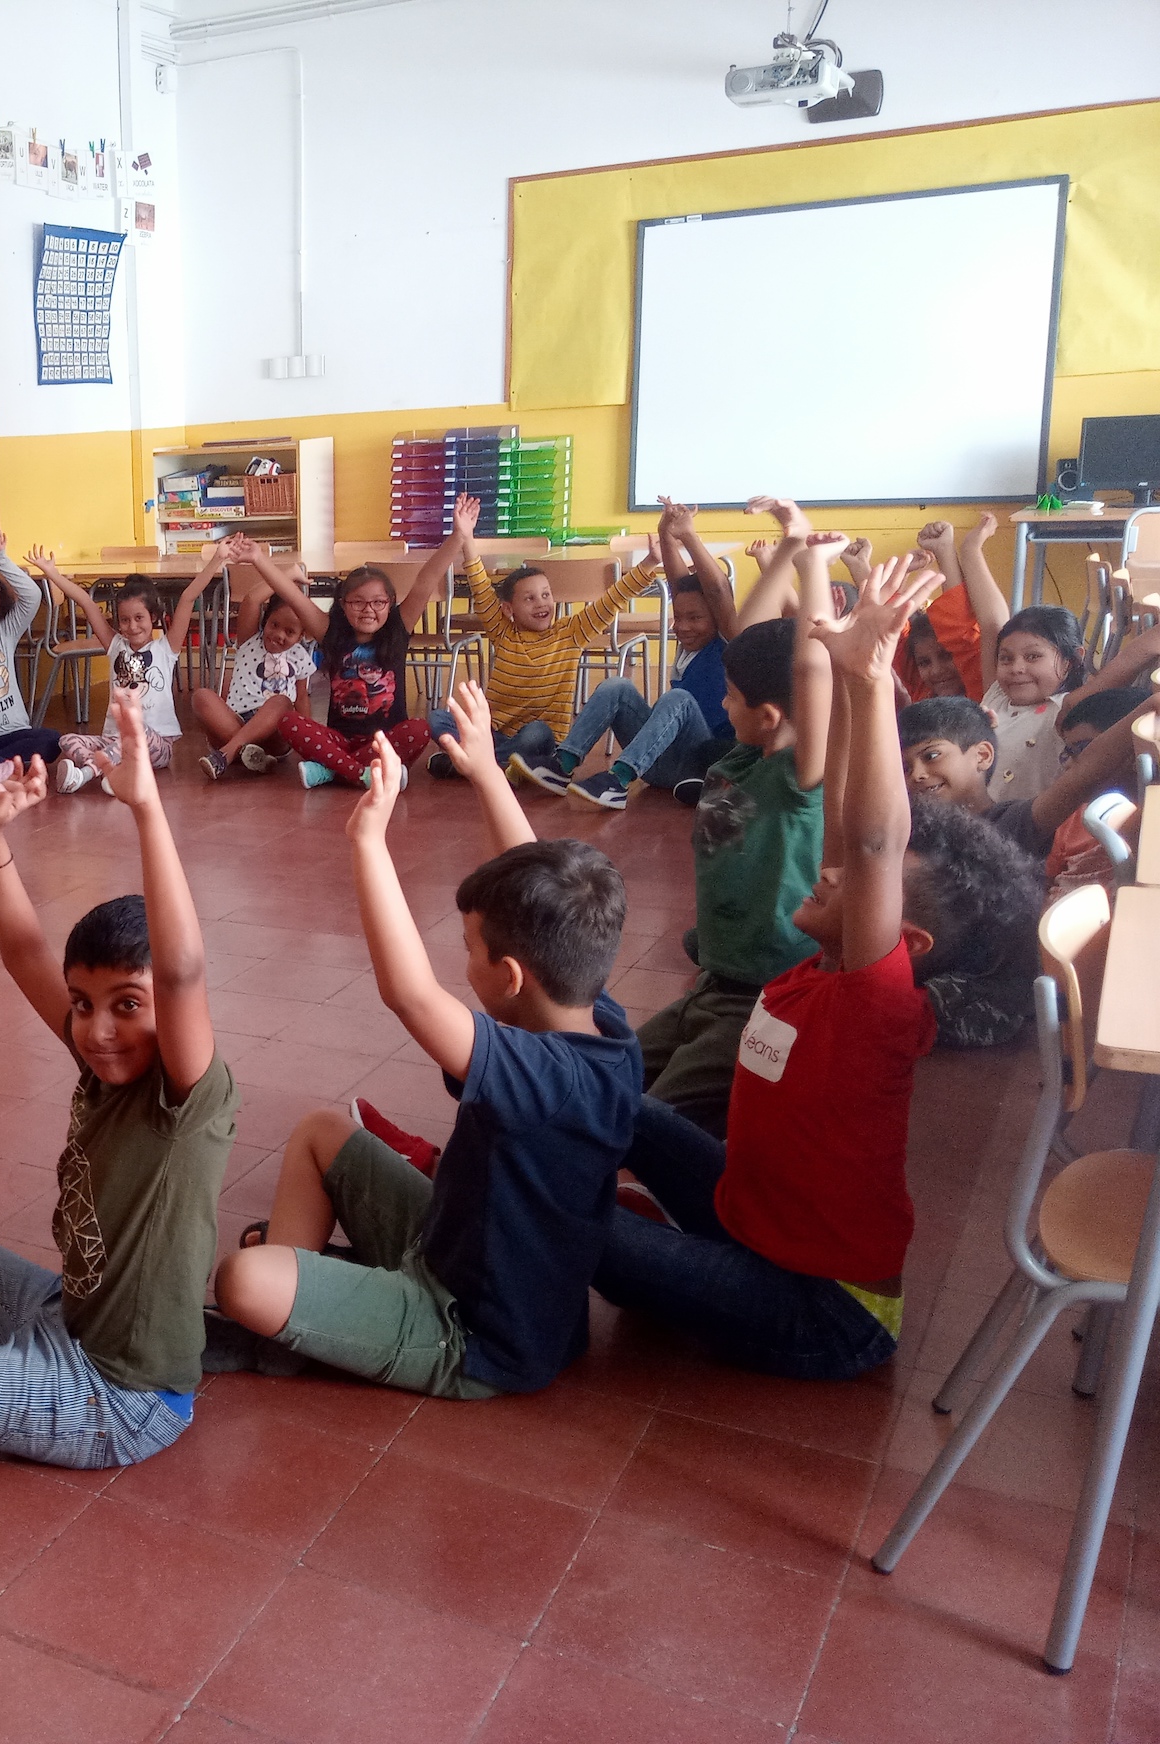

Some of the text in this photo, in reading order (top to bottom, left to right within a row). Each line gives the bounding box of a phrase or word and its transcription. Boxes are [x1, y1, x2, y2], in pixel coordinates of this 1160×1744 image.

[116, 157, 123, 169] X
[81, 241, 86, 249] 7
[111, 244, 119, 252] 10
[108, 257, 117, 265] 20
